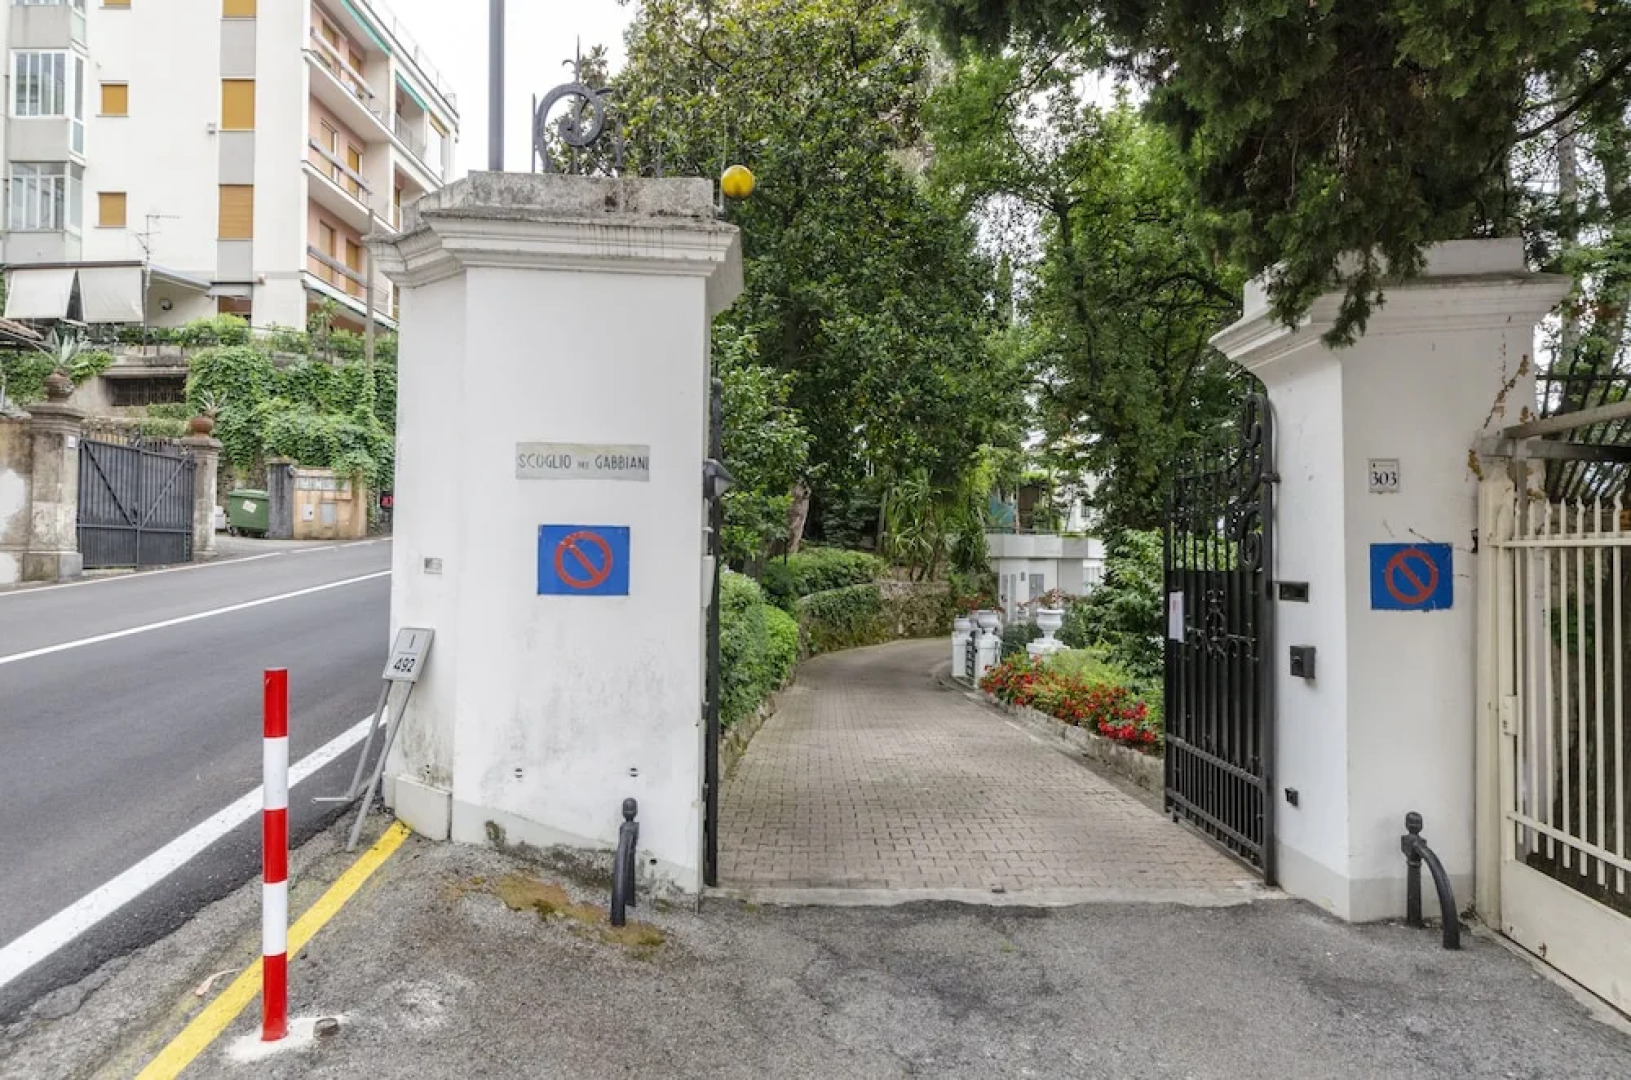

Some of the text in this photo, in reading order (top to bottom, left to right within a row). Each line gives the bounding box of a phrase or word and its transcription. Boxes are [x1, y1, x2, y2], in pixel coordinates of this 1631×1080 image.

[518, 453, 572, 469] SCOGLIO
[594, 455, 649, 470] GABBIANI
[1371, 470, 1397, 486] 303
[393, 657, 416, 673] 492
